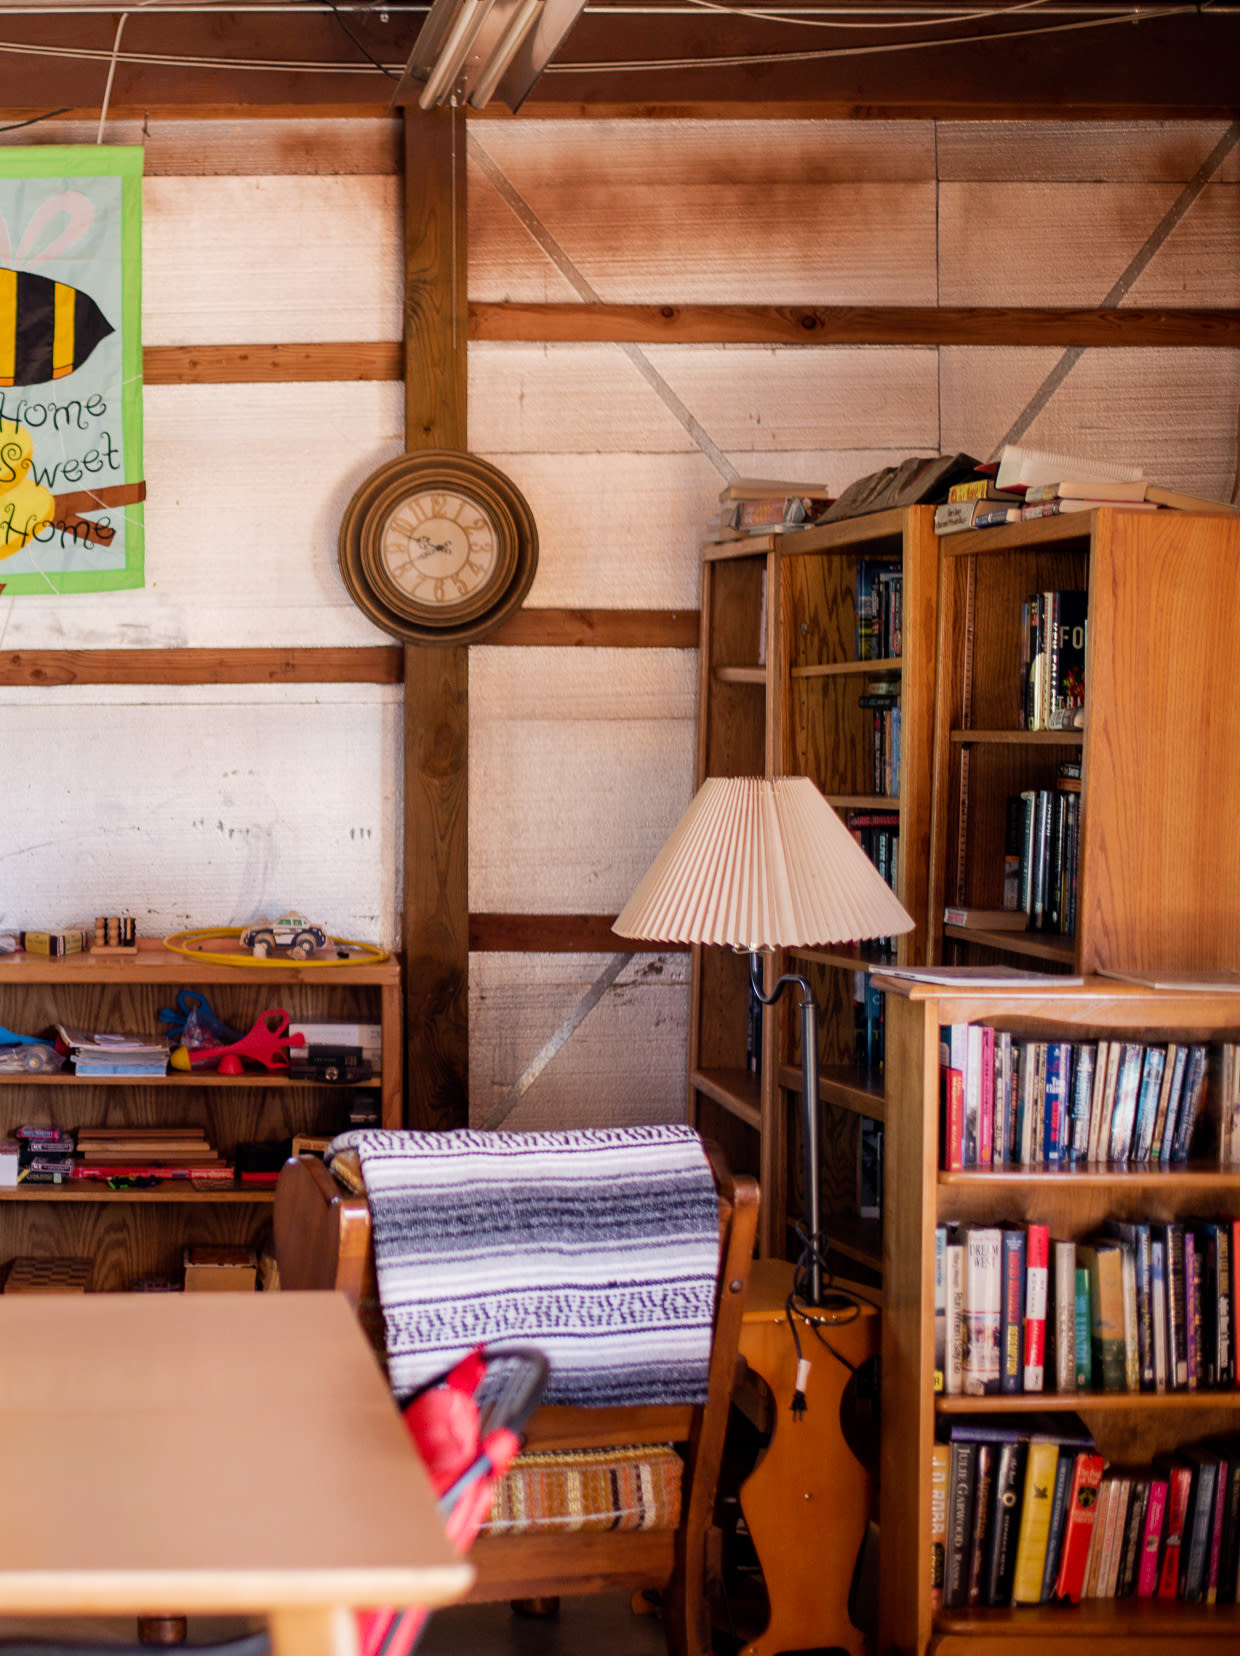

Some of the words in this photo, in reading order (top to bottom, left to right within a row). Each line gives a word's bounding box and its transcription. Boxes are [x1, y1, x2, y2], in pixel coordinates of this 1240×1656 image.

[408, 498, 428, 523] 11
[431, 494, 447, 518] 12
[455, 500, 466, 520] 1
[0, 503, 115, 549] Home
[391, 517, 415, 538] 10
[464, 518, 486, 535] 2
[384, 543, 409, 553] 9
[470, 543, 492, 552] 3
[392, 561, 413, 578] 8
[467, 560, 488, 576] 4
[411, 574, 427, 596] 7
[433, 579, 445, 602] 6
[450, 571, 468, 596] 5
[1059, 626, 1084, 650] FO
[969, 1243, 999, 1256] DREAM
[973, 1256, 996, 1269] WEST
[954, 1292, 963, 1309] Run
[954, 1311, 963, 1336] When
[952, 1343, 963, 1359] Say
[1007, 1325, 1019, 1376] REDEMPTION
[956, 1448, 971, 1480] JULIE
[954, 1483, 969, 1548] GARWOOD
